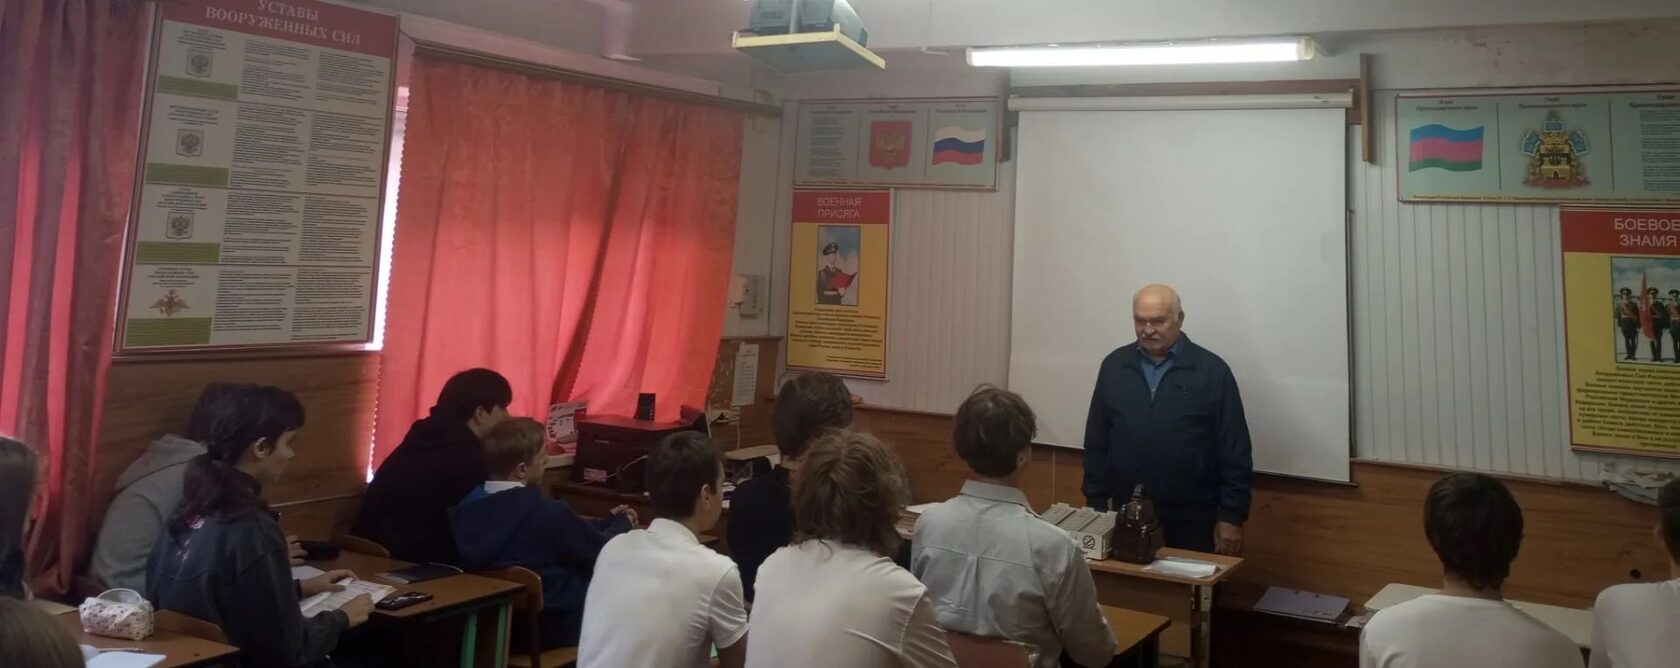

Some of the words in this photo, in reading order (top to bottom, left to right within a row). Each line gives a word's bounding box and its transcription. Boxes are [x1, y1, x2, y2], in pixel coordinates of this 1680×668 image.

[258, 0, 319, 21] УСТАВЫ
[205, 6, 328, 39] ВООРУЖЕННЫХ
[332, 30, 361, 45] СИЛ
[817, 197, 862, 206] ВОЕННАЯ
[817, 208, 861, 217] ПРИСЯГА
[1614, 218, 1680, 231] БОЕВОЕ
[1620, 234, 1677, 247] ЗНАМЯ
